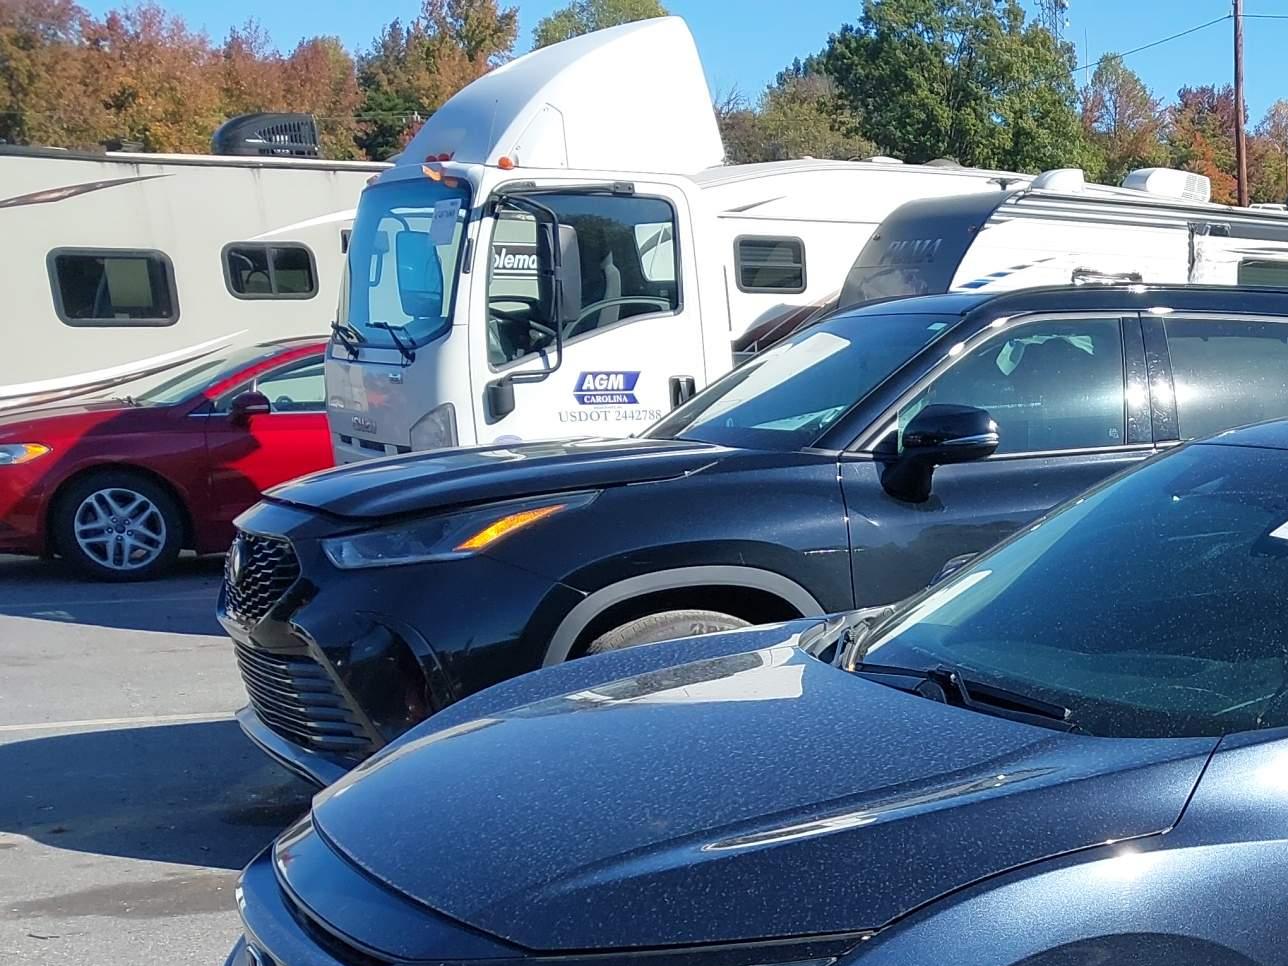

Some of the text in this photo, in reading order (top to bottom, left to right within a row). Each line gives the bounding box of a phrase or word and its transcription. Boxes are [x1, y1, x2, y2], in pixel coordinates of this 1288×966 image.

[582, 374, 624, 391] AGM
[584, 395, 628, 403] CAROLINA
[559, 409, 662, 422] USDOT 2442788
